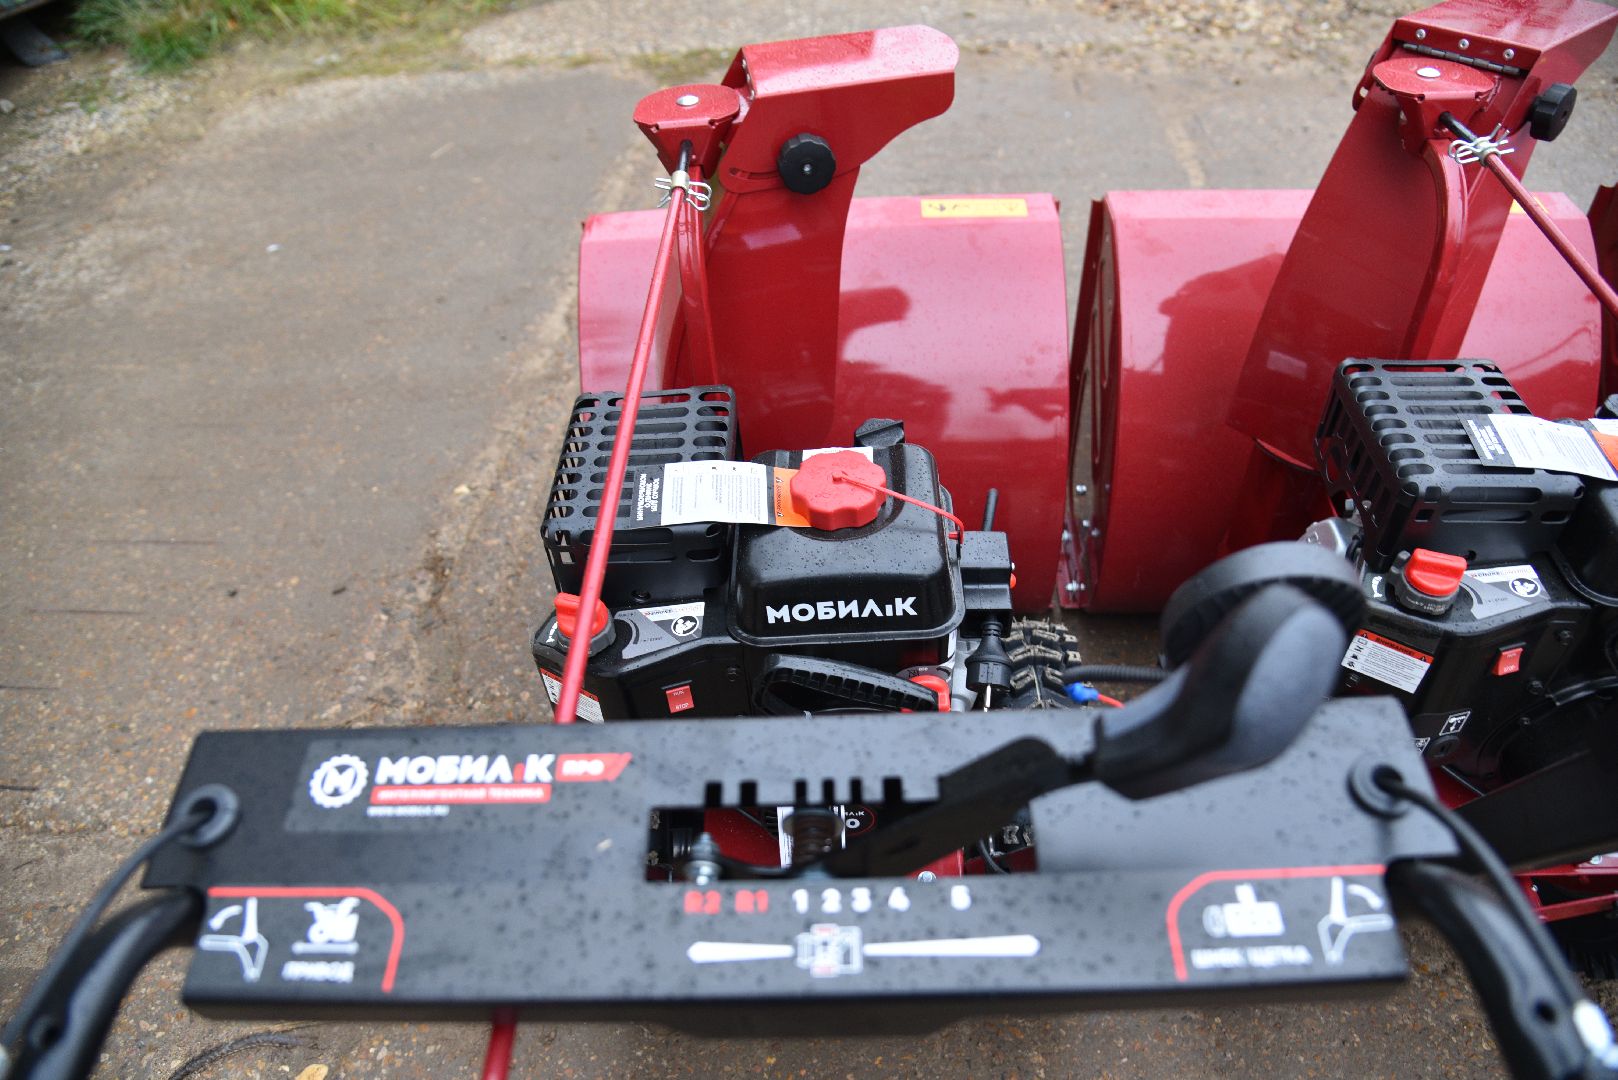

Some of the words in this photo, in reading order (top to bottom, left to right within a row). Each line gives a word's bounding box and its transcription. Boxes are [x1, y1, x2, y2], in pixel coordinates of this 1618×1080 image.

[792, 888, 809, 914] 1
[821, 887, 842, 914] 2
[850, 886, 872, 913] 3
[887, 885, 910, 912] 4
